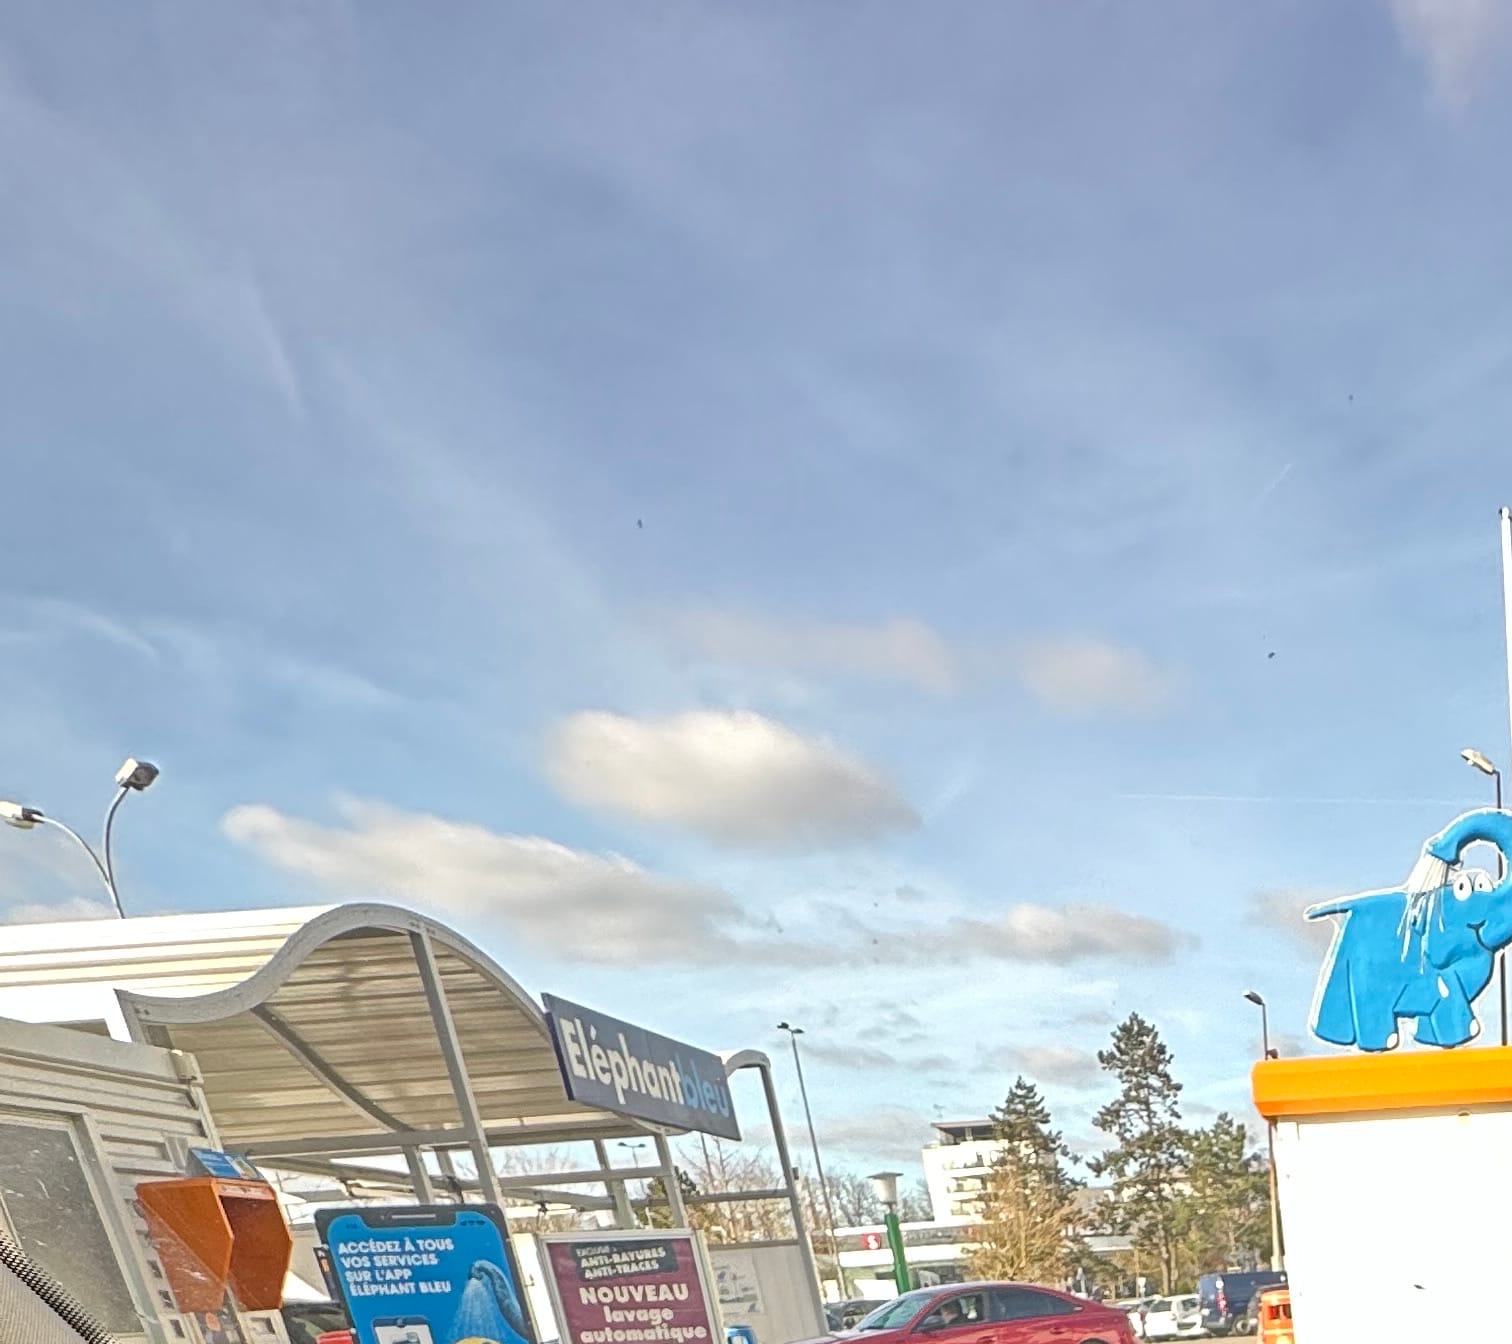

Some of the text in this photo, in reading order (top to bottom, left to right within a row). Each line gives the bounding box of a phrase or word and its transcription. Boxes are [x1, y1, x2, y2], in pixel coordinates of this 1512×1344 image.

[338, 1236, 454, 1254] ACCÉDEZ À TOUS
[340, 1253, 439, 1268] VOS SERVICES
[581, 1246, 666, 1268] ANTI-RAYURES
[345, 1268, 412, 1283] SUR L'APP
[585, 1259, 659, 1280] ANTI-TRACES
[350, 1280, 451, 1297] ÉLÉPHANT BLEU
[579, 1283, 689, 1305] NOUVEAU
[603, 1306, 674, 1325] lavage
[580, 1322, 707, 1344] automatique
